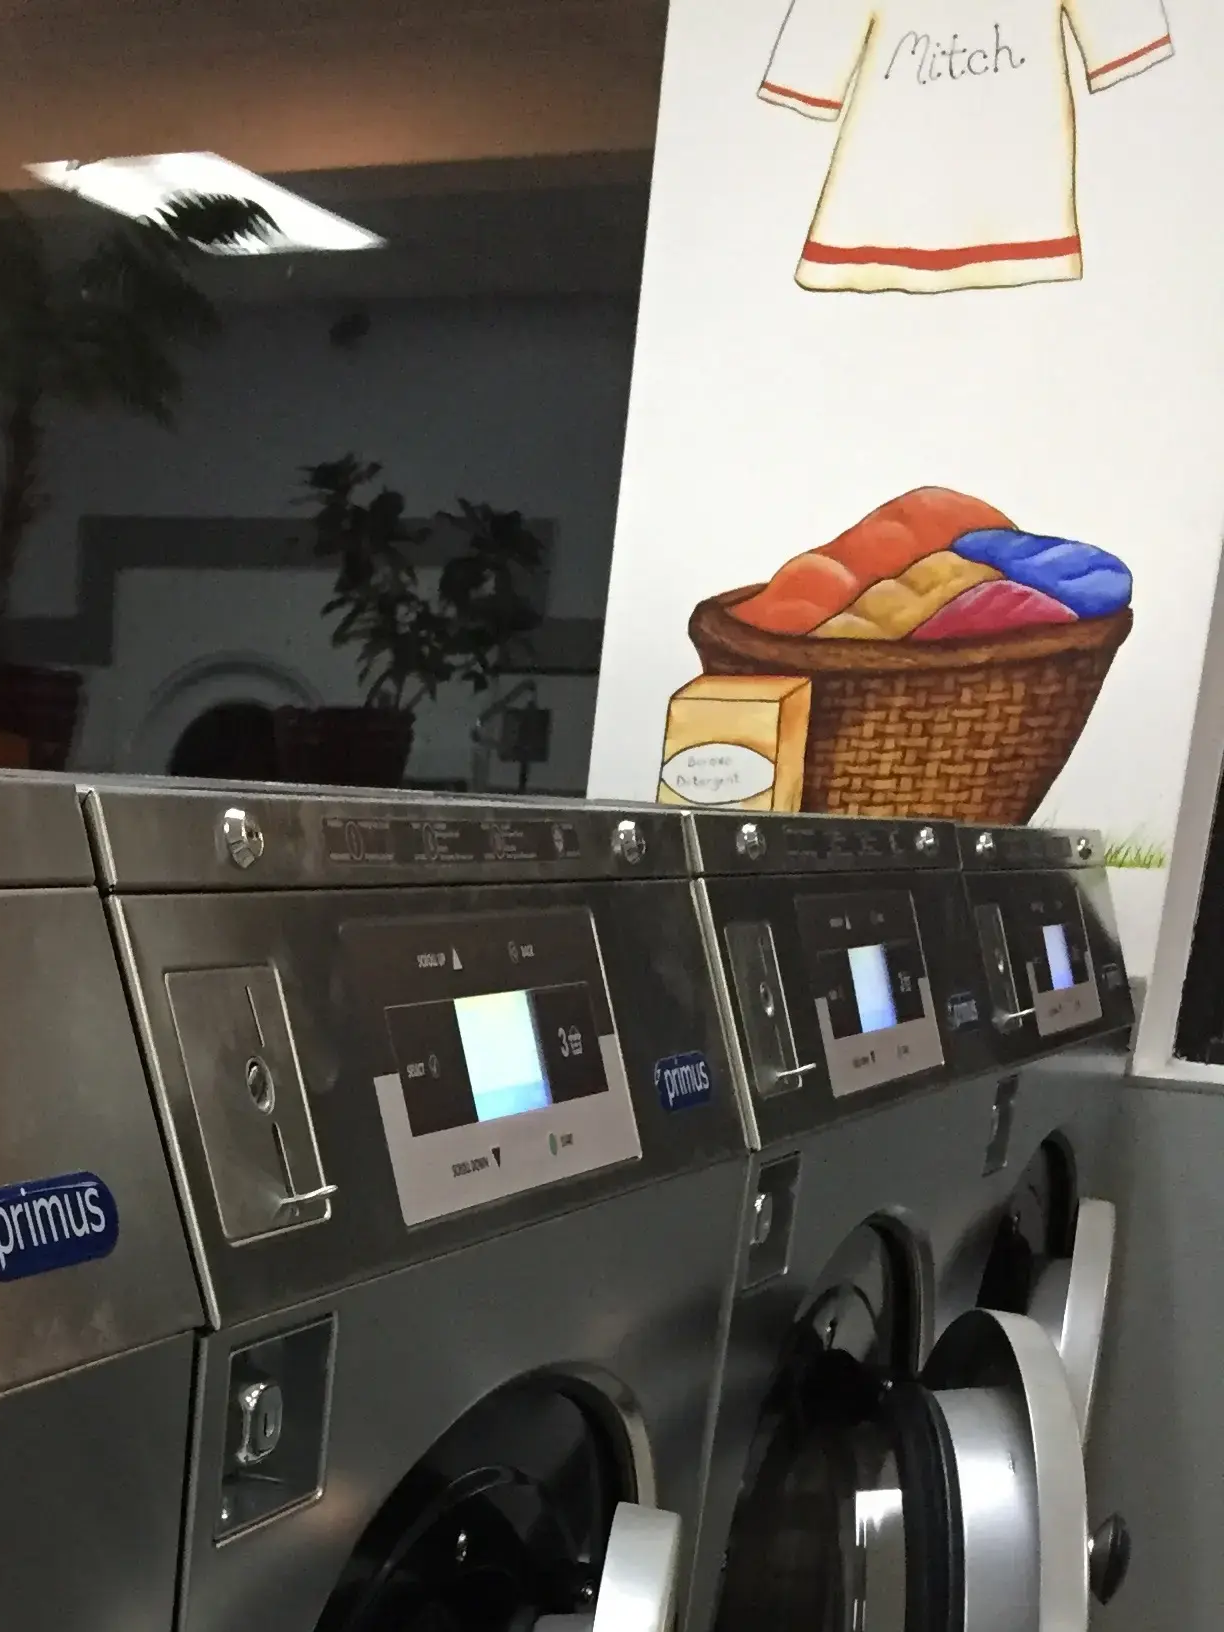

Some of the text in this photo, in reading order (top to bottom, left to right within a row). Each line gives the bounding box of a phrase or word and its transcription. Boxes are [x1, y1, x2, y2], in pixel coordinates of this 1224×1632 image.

[884, 22, 1026, 85] Mitch
[557, 1027, 570, 1057] 3
[663, 1061, 710, 1107] primus
